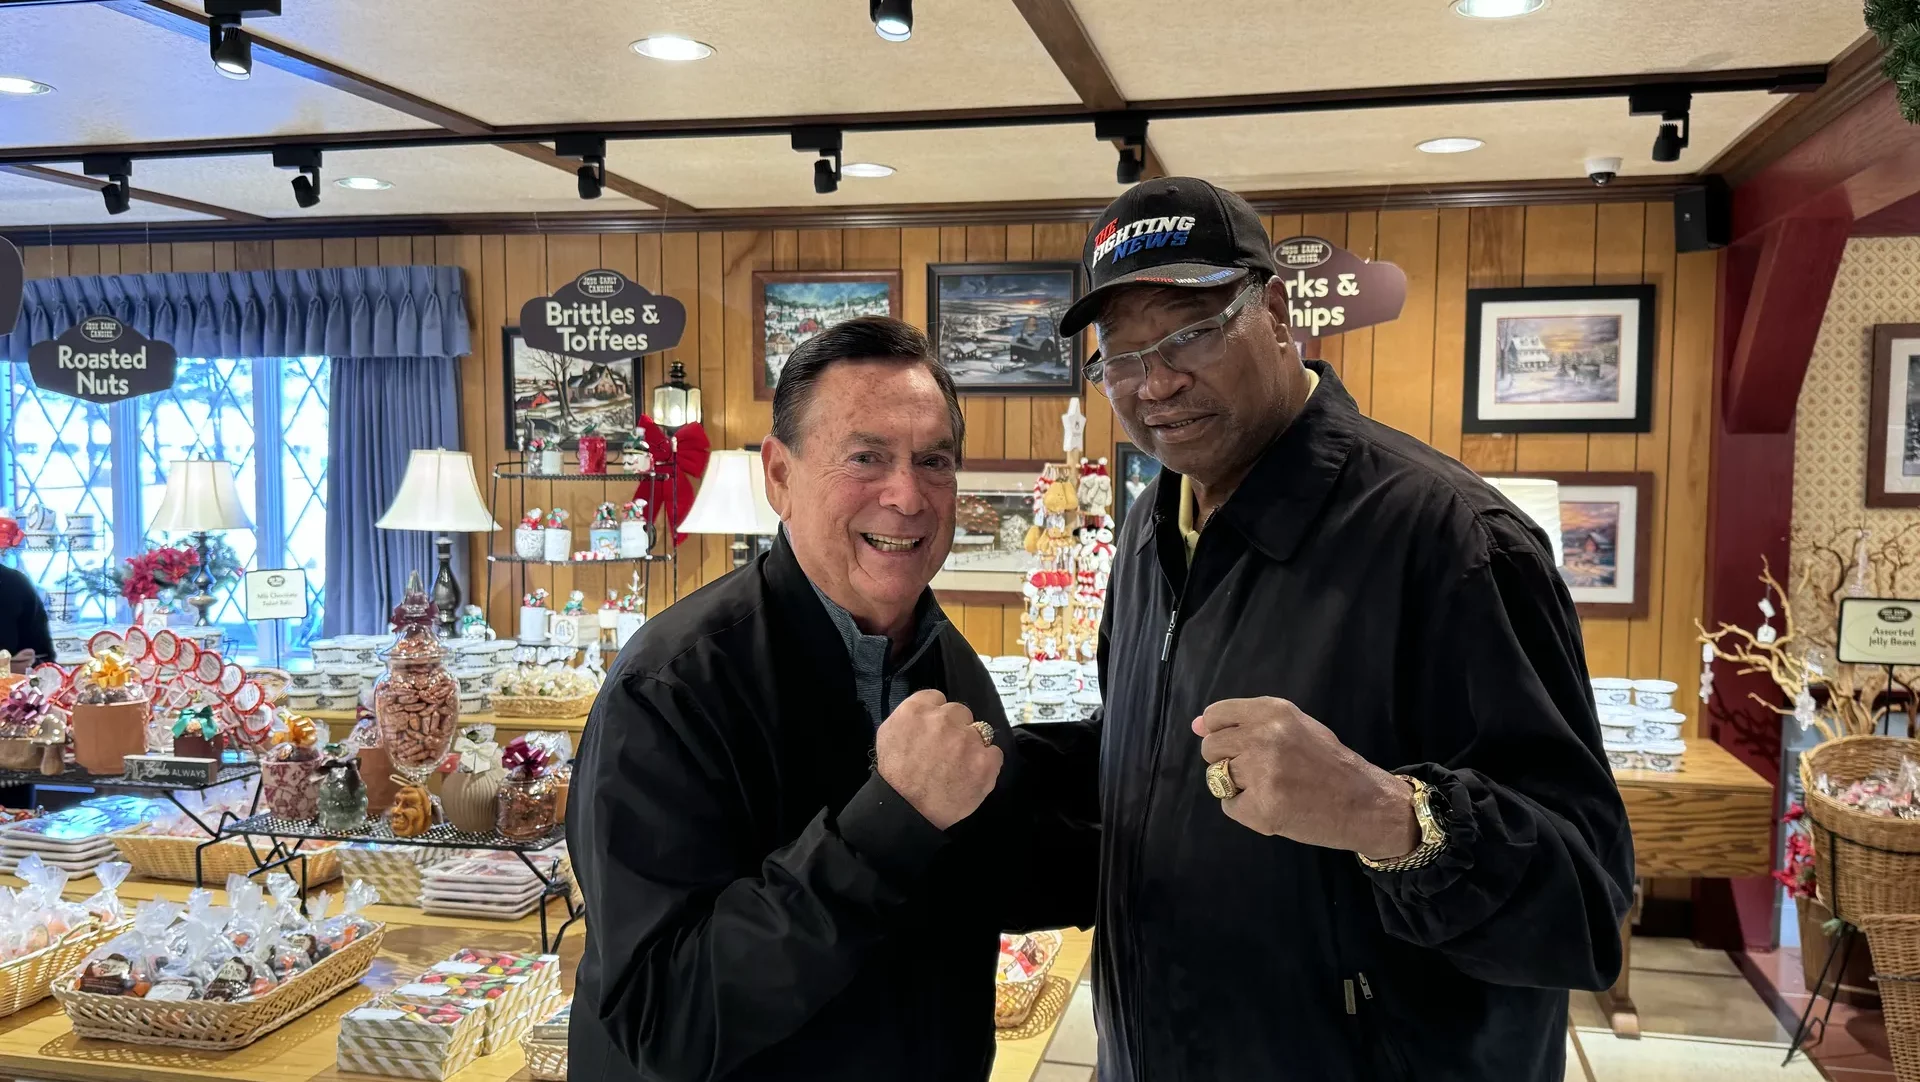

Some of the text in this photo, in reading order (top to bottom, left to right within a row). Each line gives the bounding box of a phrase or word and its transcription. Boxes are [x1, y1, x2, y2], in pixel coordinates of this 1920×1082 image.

[1092, 216, 1196, 269] FIGHTING
[1094, 217, 1119, 246] THE
[1111, 230, 1190, 265] NEWS
[1337, 273, 1360, 297] &
[545, 300, 660, 326] Brittles &
[556, 326, 649, 352] Toffees
[58, 345, 147, 370] Roasted
[77, 371, 129, 396] Nuts
[1869, 636, 1917, 648] Jelly Beans
[1872, 626, 1915, 637] Assorted
[171, 769, 207, 779] ALWAYS
